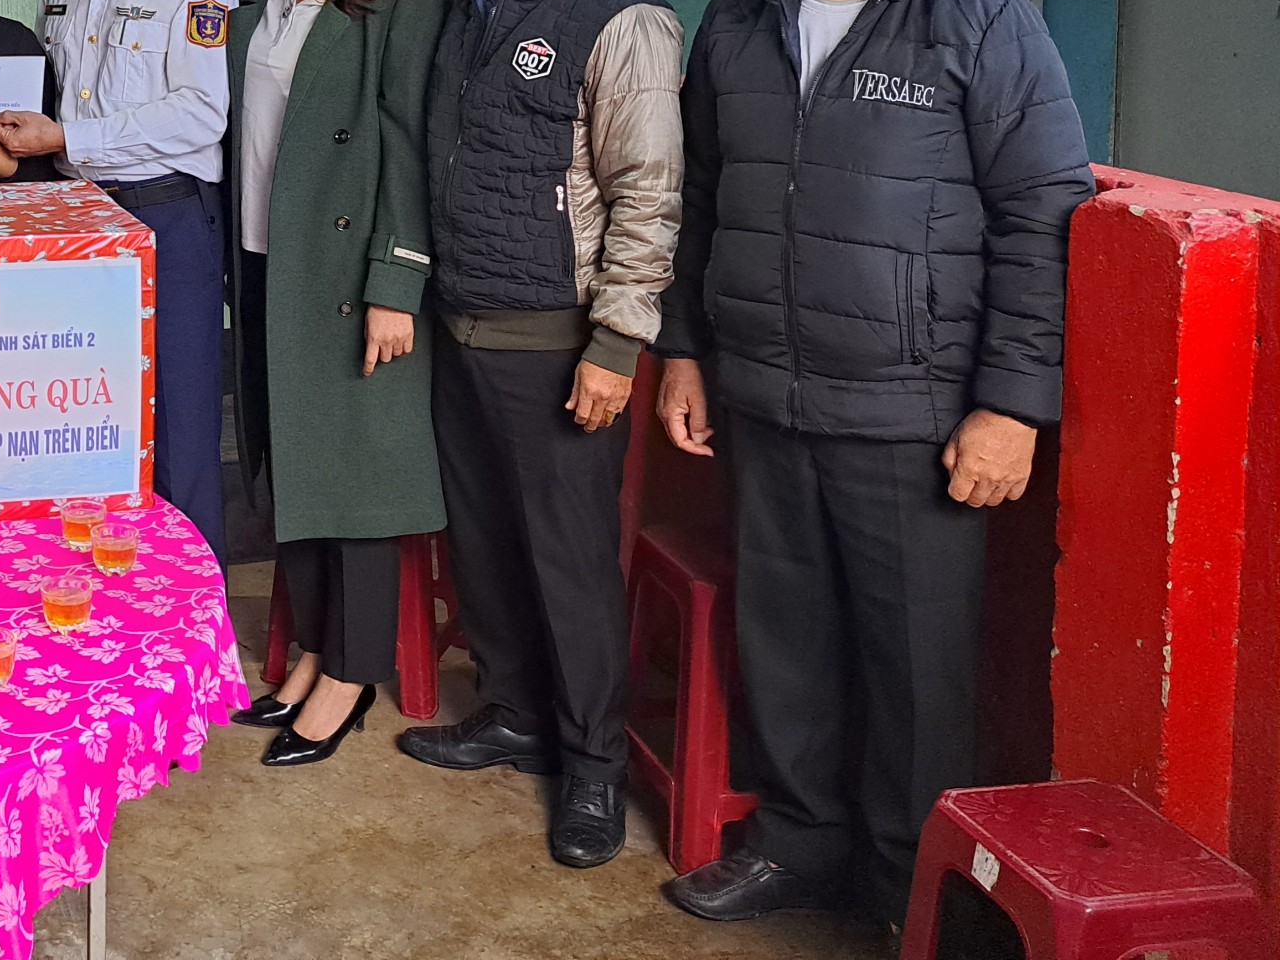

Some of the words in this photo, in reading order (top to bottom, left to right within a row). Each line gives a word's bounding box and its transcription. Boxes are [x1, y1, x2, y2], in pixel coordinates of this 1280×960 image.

[518, 51, 549, 71] 007
[852, 69, 936, 108] VERSAEC
[22, 331, 48, 350] SÁT
[51, 326, 83, 349] BIỂN
[87, 332, 95, 348] 2
[47, 367, 113, 414] QUÀ
[8, 430, 40, 462] NẠN
[44, 422, 81, 455] TRÊN
[85, 414, 120, 452] BIỂN
